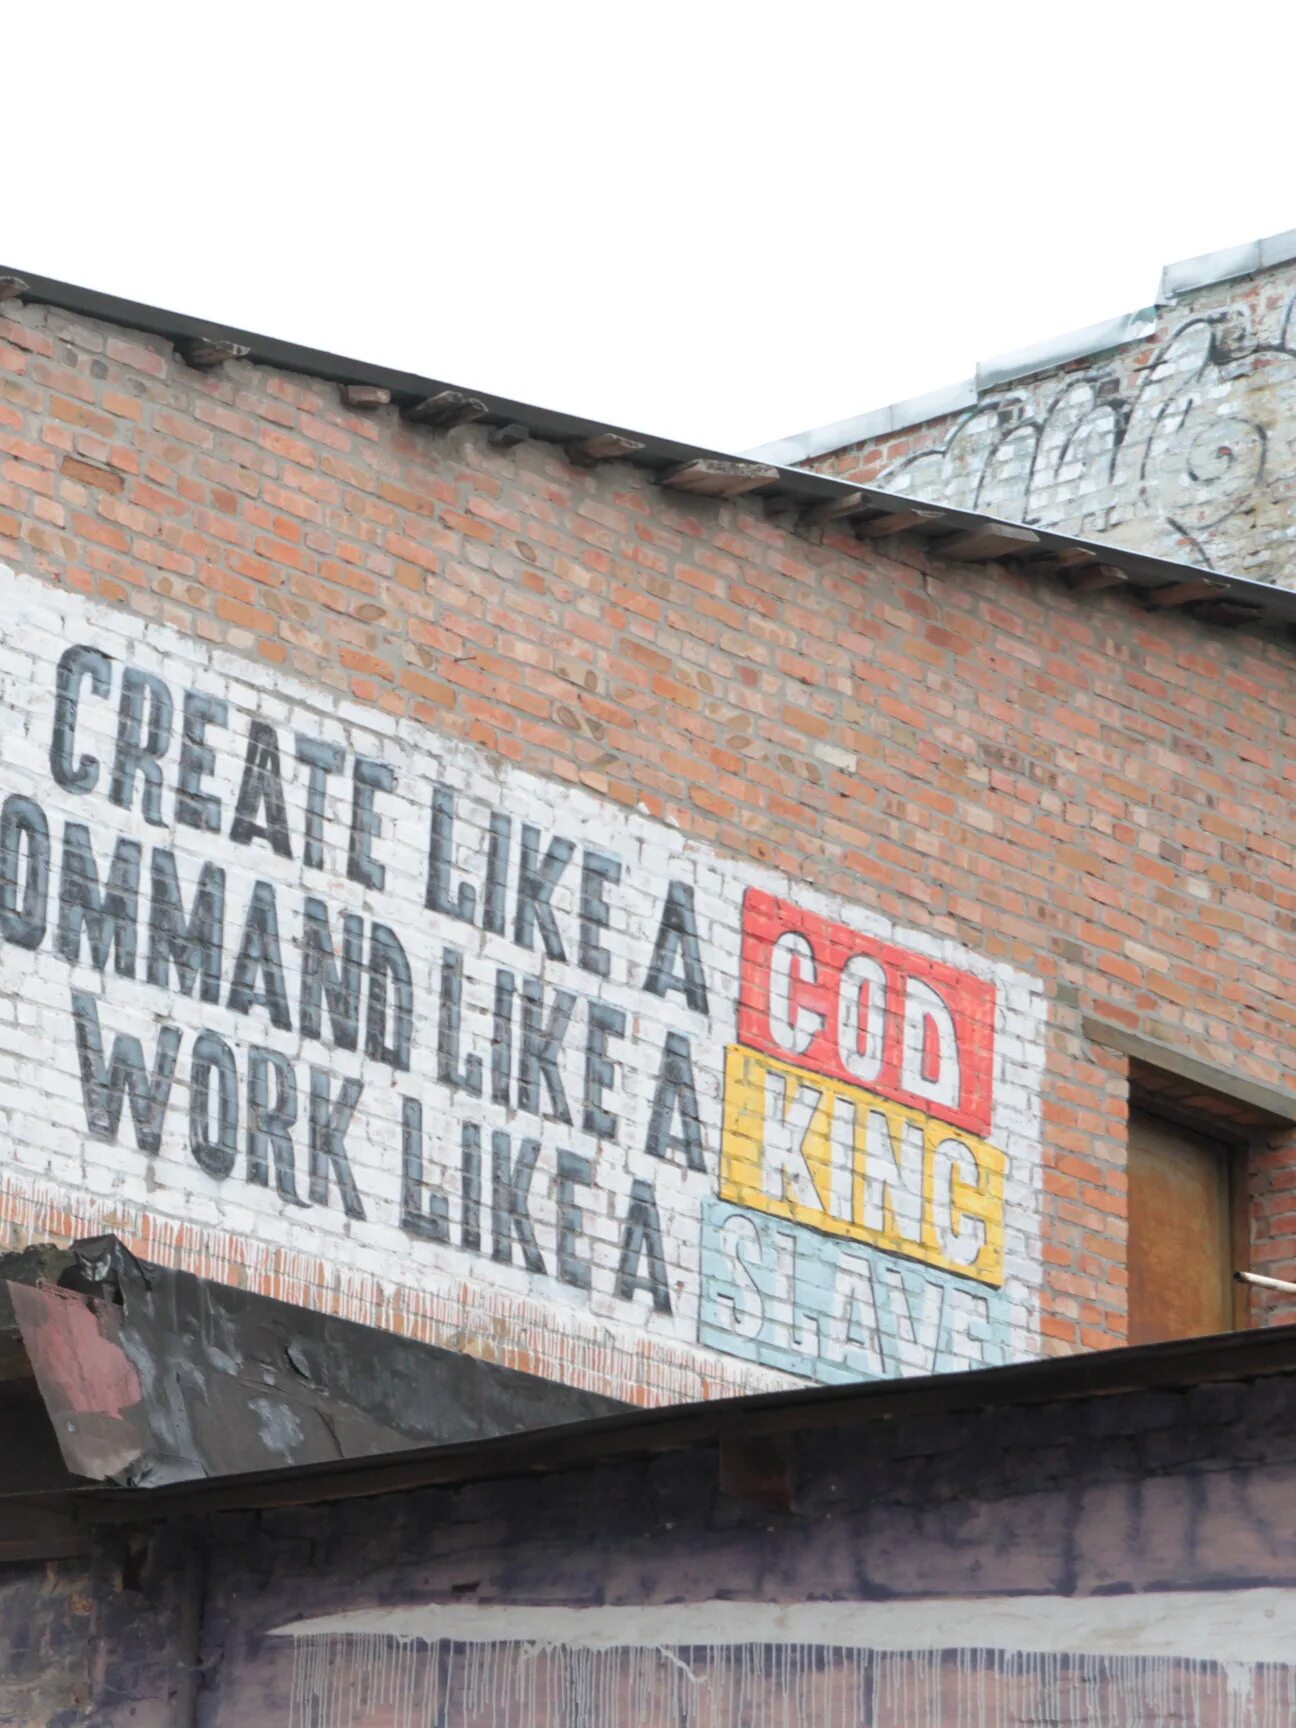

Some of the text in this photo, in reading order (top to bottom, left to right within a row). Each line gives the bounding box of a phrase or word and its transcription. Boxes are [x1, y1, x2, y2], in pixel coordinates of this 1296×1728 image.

[48, 644, 962, 1110] CREATE LIKE A GOD
[70, 988, 996, 1378] WORK LIKE A SLAVE
[438, 946, 628, 1140] LIKE
[644, 1030, 707, 1175] A
[760, 1068, 988, 1268] KING
